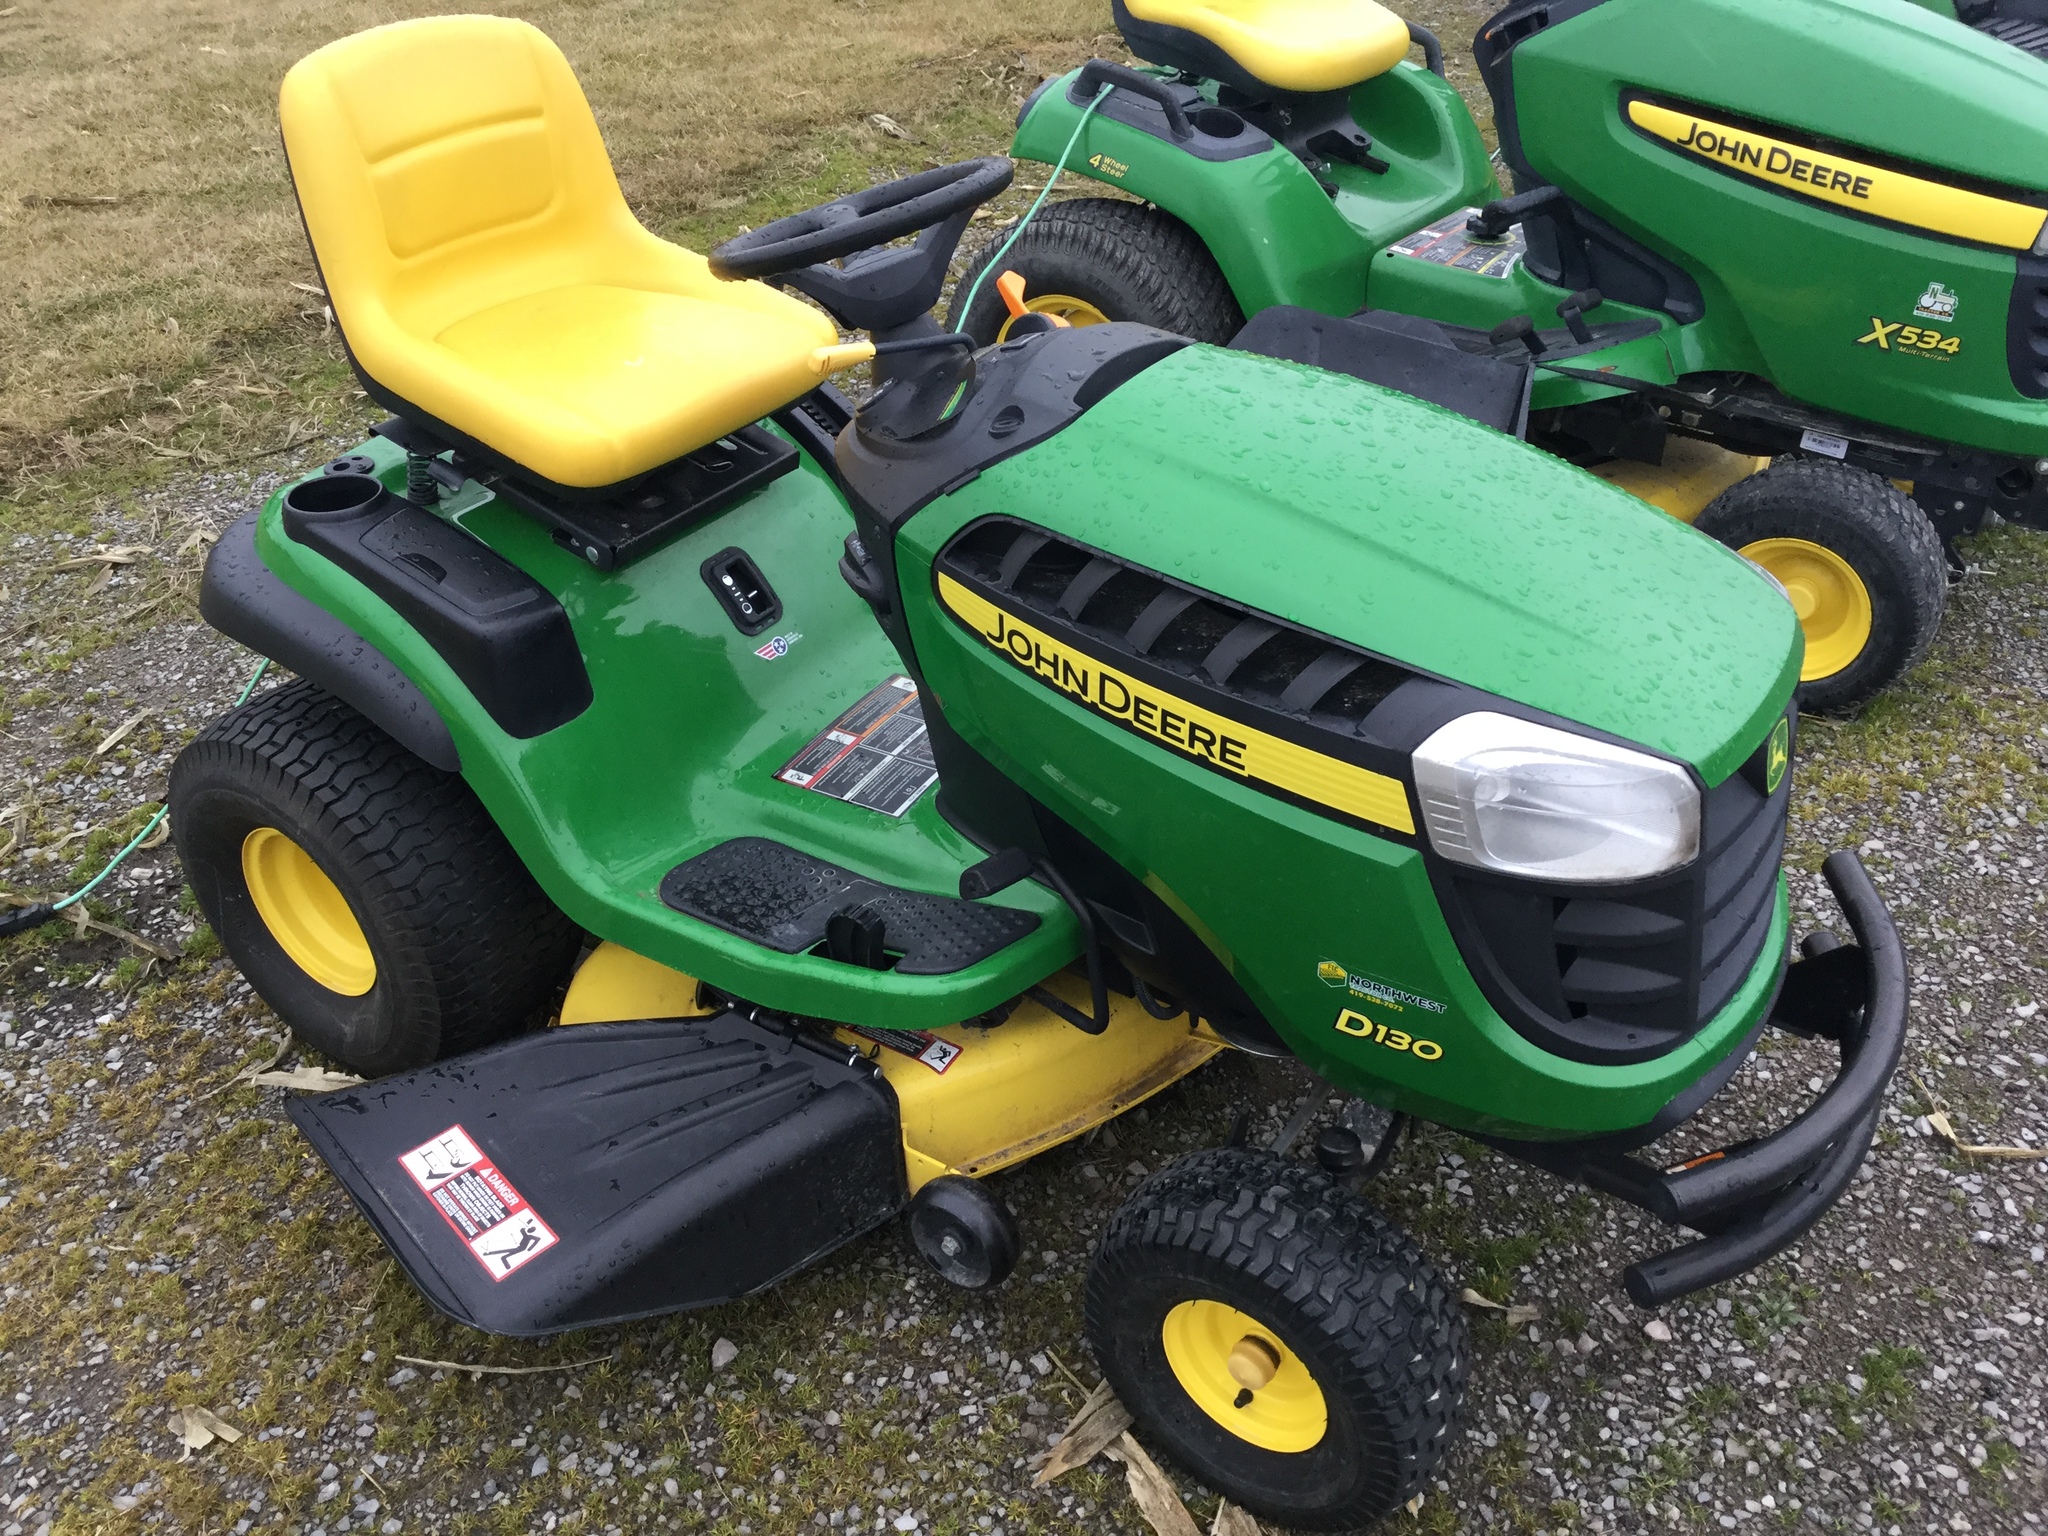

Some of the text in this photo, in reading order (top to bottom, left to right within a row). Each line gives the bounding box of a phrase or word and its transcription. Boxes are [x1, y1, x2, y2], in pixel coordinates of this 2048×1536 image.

[1088, 153, 1130, 172] 4 Wheel
[1100, 163, 1125, 179] Steer
[1676, 122, 1874, 200] JOHN DEERE
[1855, 316, 1962, 355] X534
[985, 612, 1247, 772] JOHN DEERE
[1349, 974, 1448, 1015] NORTHWEST
[1334, 1008, 1444, 1062] D130
[474, 1175, 494, 1197] ROTATING
[490, 1193, 505, 1210] BLADE
[487, 1173, 520, 1207] DANGER
[473, 1198, 492, 1220] OBJECTS
